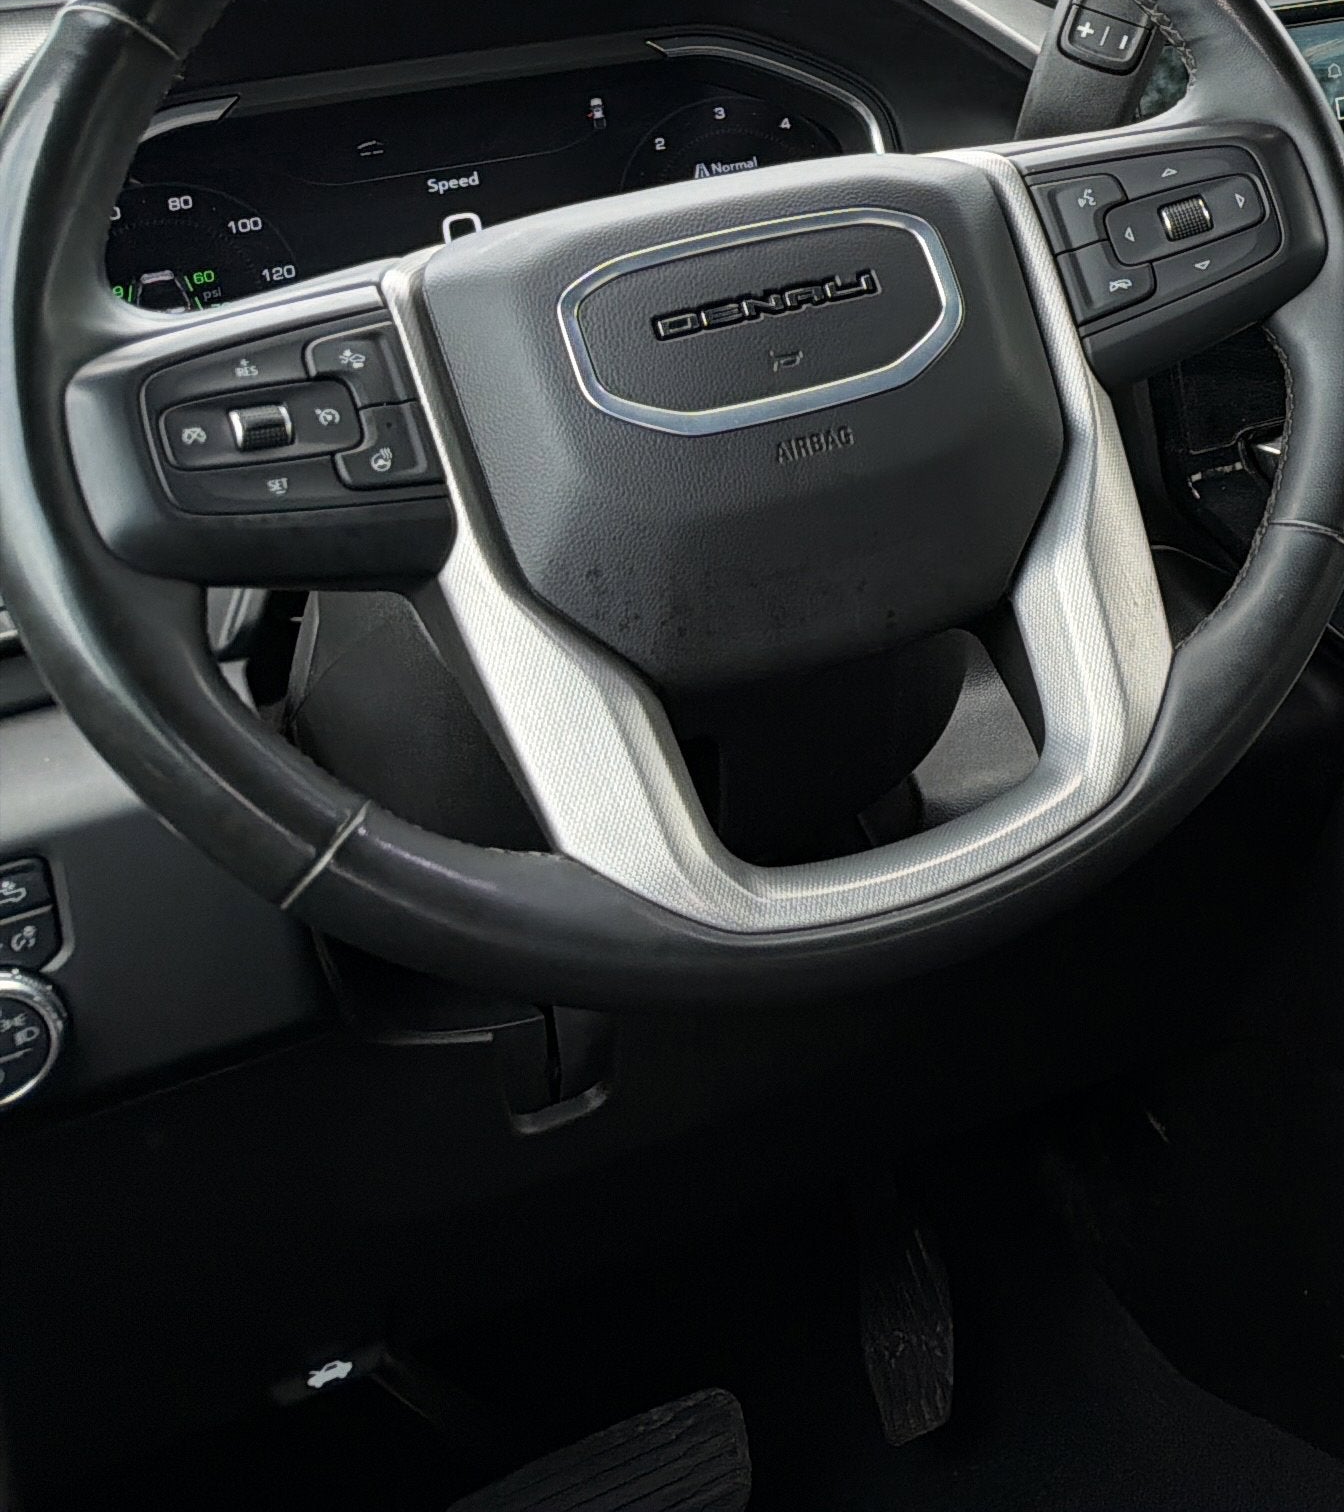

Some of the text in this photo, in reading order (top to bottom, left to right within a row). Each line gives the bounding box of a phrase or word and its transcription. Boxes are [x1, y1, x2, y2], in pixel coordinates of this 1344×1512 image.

[713, 105, 727, 121] 3
[778, 116, 793, 131] 4
[654, 136, 667, 151] 2
[710, 155, 758, 176] Normal
[426, 170, 481, 195] Speed
[167, 195, 193, 212] 80
[227, 216, 263, 234] 100
[192, 269, 216, 285] 60
[261, 264, 297, 282] 120
[202, 286, 223, 302] psi
[654, 268, 882, 339] DENALI
[234, 364, 259, 378] RES
[776, 425, 857, 465] AIRBAG
[266, 477, 288, 492] SET
